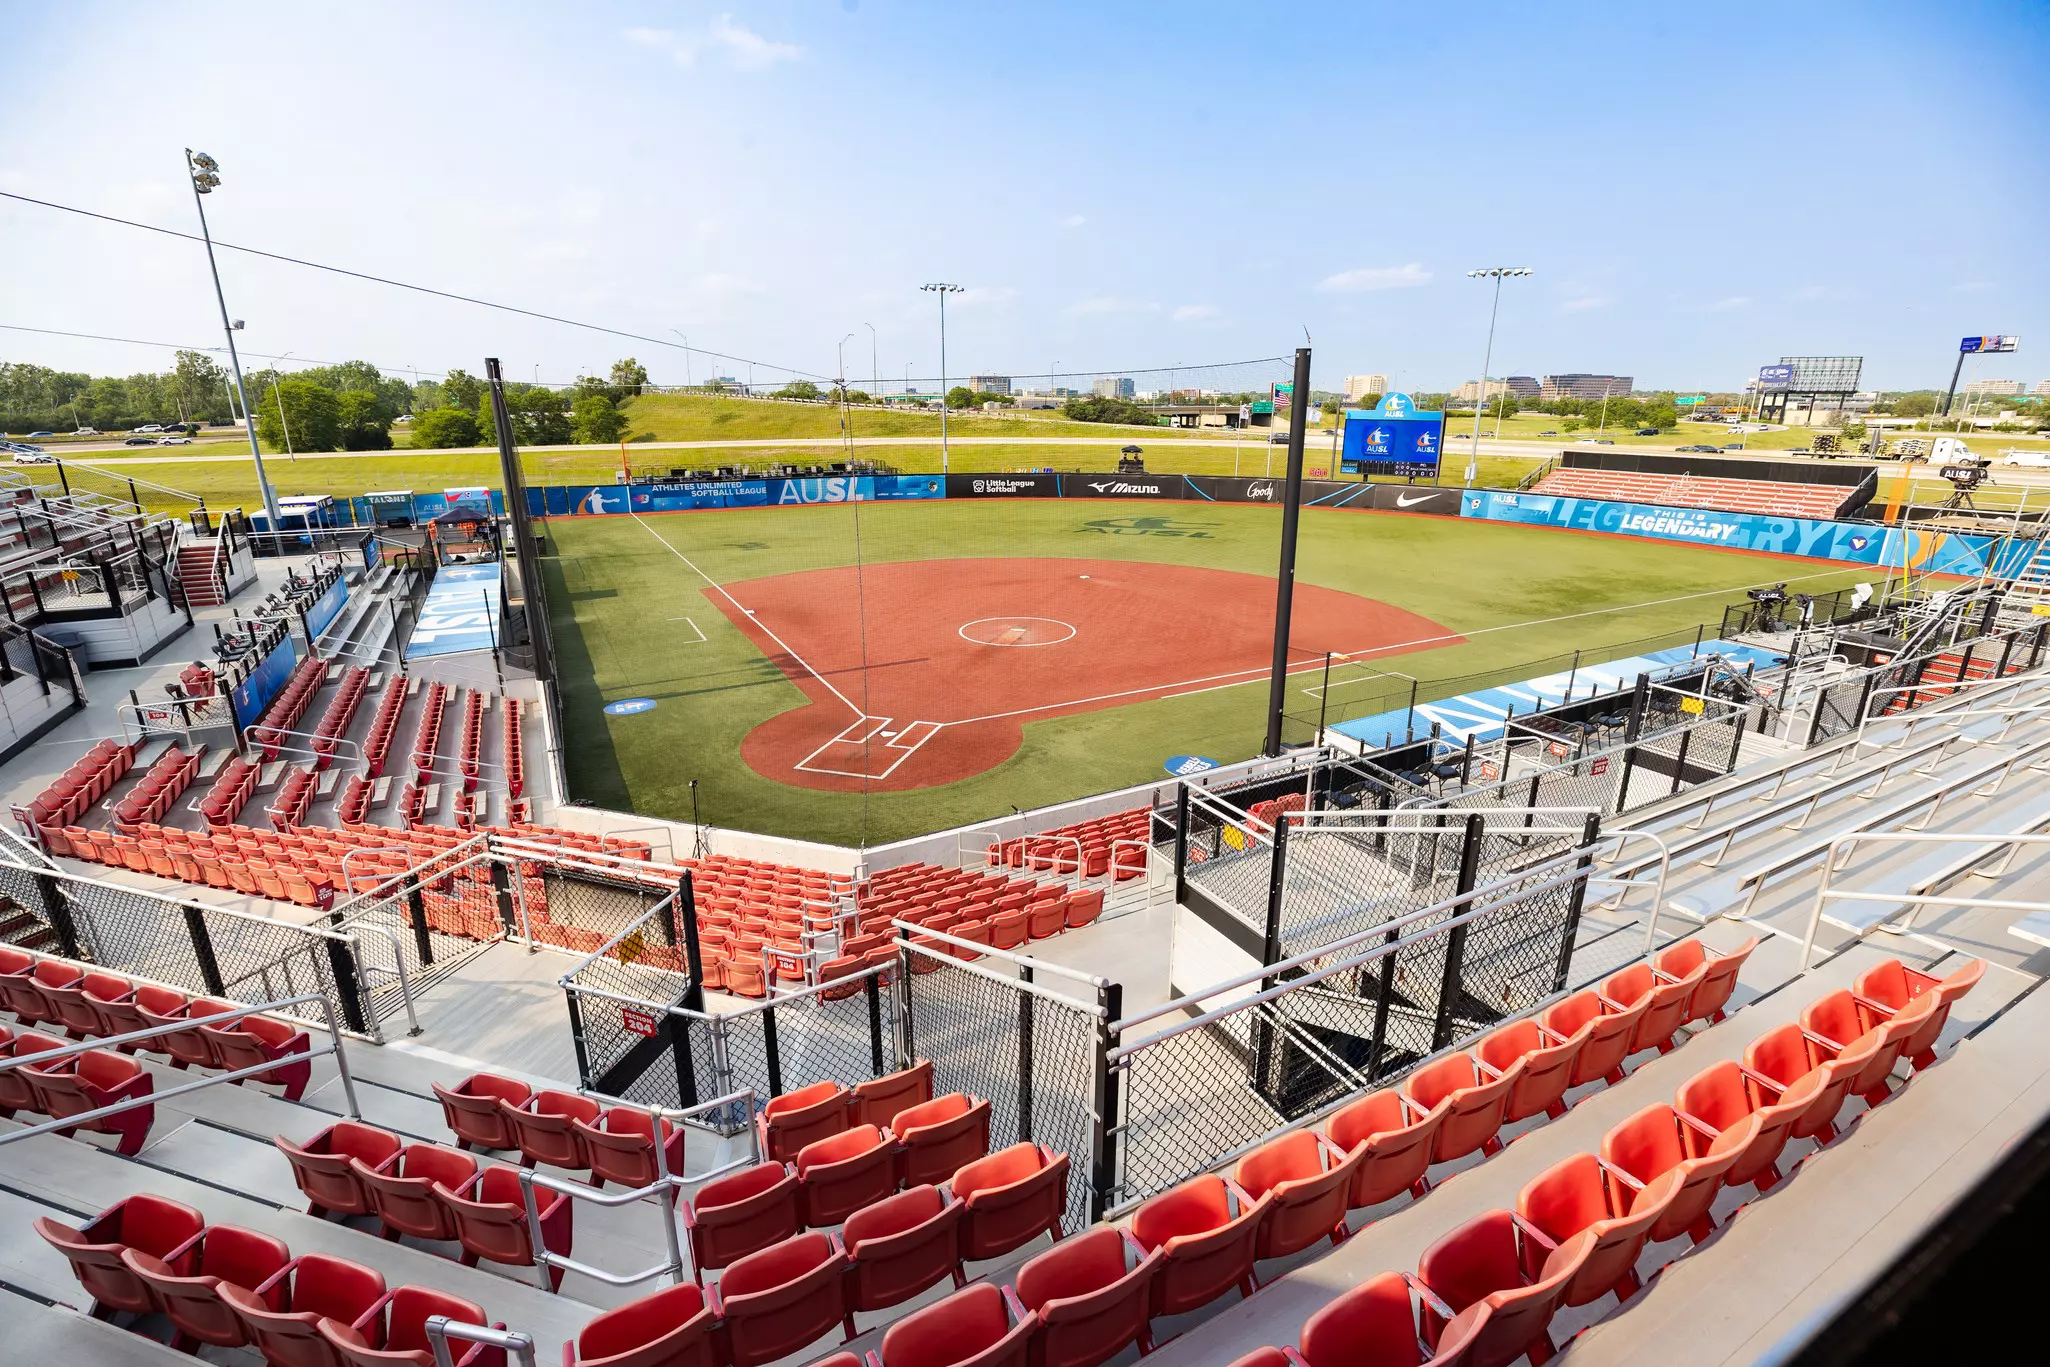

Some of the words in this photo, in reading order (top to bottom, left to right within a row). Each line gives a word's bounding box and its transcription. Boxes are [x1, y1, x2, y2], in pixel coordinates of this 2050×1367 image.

[1945, 470, 1971, 478] AUSL
[652, 483, 695, 492] ATHLETES
[697, 481, 743, 490] UNLIMITED
[1007, 480, 1035, 488] League
[691, 489, 734, 497] SOFTBALL
[736, 486, 767, 495] LEAGUE
[778, 477, 865, 505] AUSL
[1247, 481, 1273, 500] Goody
[369, 496, 406, 504] TALONS
[1493, 495, 1518, 504] AUSL
[1654, 510, 1685, 518] THIS
[1691, 513, 1706, 521] IS
[1621, 513, 1738, 540] LEGENDARY
[1073, 528, 1215, 539] AUSL
[780, 960, 794, 970] 104
[624, 1012, 652, 1024] SECTION
[628, 1019, 652, 1033] 204
